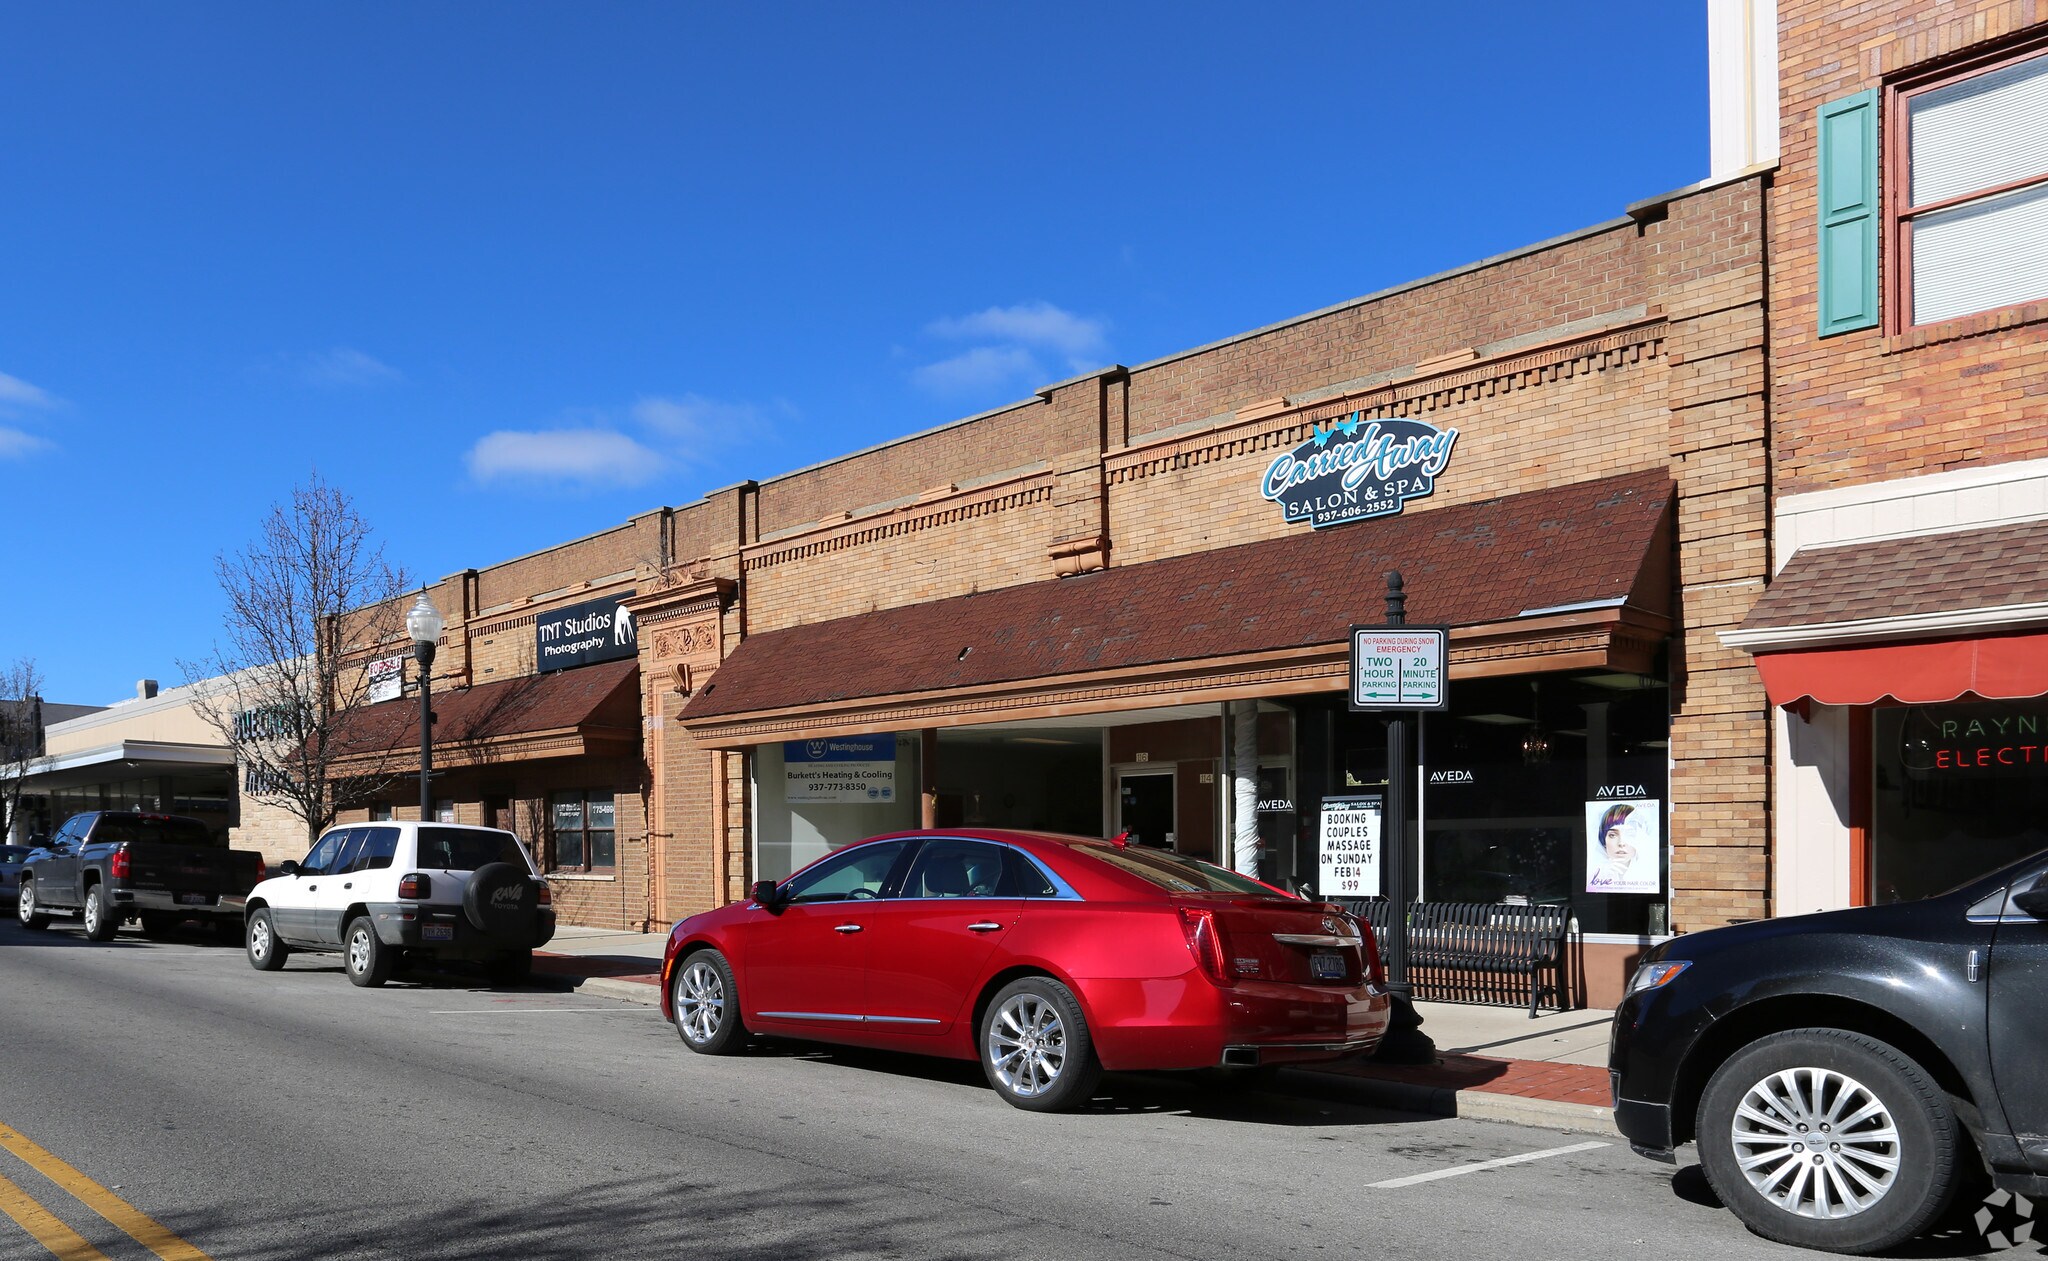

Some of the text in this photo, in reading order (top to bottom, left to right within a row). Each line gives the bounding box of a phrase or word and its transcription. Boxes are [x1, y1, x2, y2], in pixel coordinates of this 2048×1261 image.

[1262, 424, 1458, 499] Carried Away
[1289, 477, 1425, 515] SALON & SPA
[1317, 499, 1394, 522] 937-606-2552
[539, 612, 611, 642] TNT Studios
[545, 636, 605, 656] Photography
[1372, 637, 1396, 645] PARKING
[1366, 657, 1392, 667] TWO
[1413, 657, 1427, 667] 20
[1364, 669, 1394, 678] HOUR
[1402, 669, 1436, 678] MINUTE
[1403, 681, 1437, 689] PARKING
[1942, 715, 2048, 739] RAYN
[829, 743, 874, 752] Westinghouse
[823, 771, 852, 780] Heating
[862, 771, 893, 780] Cooling
[1430, 770, 1474, 782] AVEDA
[808, 783, 866, 791] 937-773-8350
[1596, 785, 1647, 797] AVEDA
[1257, 799, 1293, 810] AVEDA
[1328, 813, 1366, 824] BOOKING
[1327, 826, 1368, 838] COUPLES
[1327, 840, 1371, 851] MASSAGE
[1321, 854, 1373, 864] ON SUNDAY
[1590, 868, 1613, 886] love
[1342, 881, 1359, 891] $99
[494, 902, 520, 911] TOYOTA
